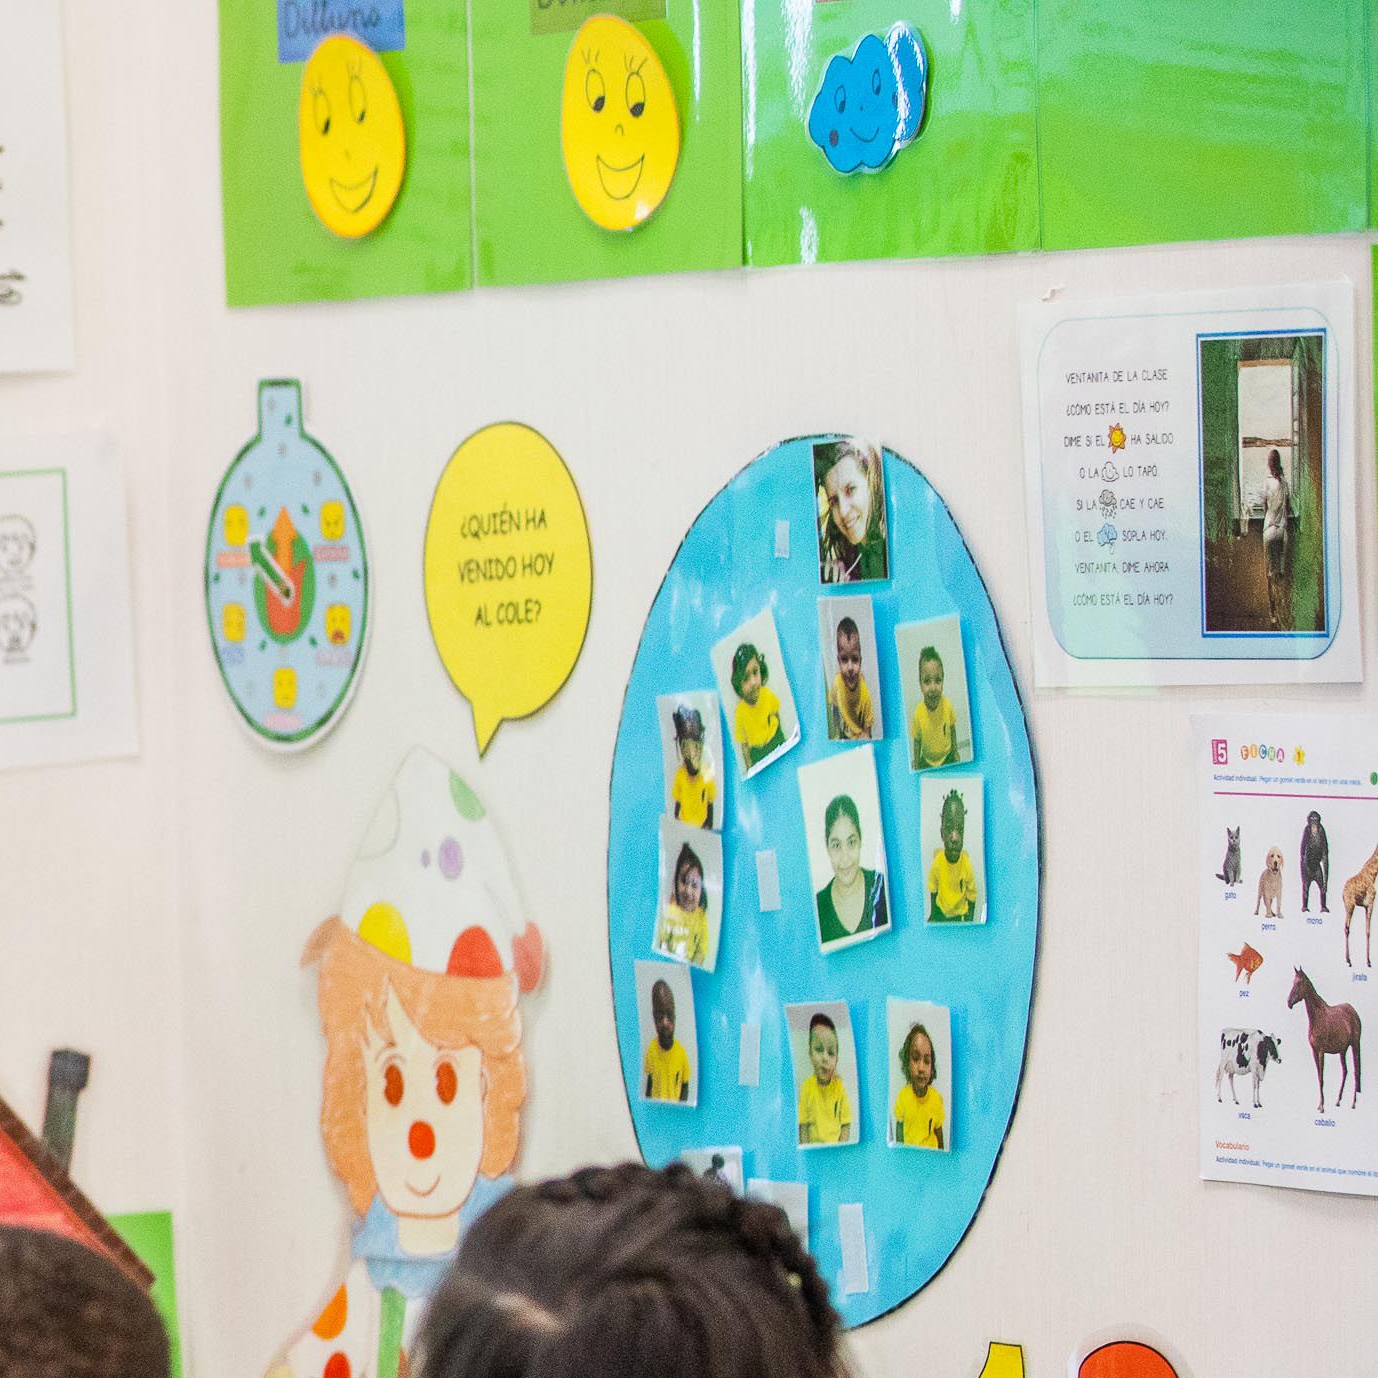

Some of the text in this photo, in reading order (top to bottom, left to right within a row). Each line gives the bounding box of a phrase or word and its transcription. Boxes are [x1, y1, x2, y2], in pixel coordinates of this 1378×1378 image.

[1065, 368, 1169, 384] VENTANITA DE LA CLASE
[1095, 401, 1116, 415] ESTÁ
[1119, 402, 1130, 414] EL
[1132, 400, 1146, 414] DÍA
[1149, 400, 1170, 414] HOY?
[1064, 435, 1082, 447] DIME
[1085, 435, 1093, 447] SI
[1095, 435, 1106, 447] EL
[1130, 433, 1142, 445] HA
[1079, 467, 1085, 479] O
[1088, 467, 1099, 479] LA
[1123, 465, 1134, 478] LO
[1086, 499, 1097, 511] LA
[1120, 498, 1136, 510] CAE
[1139, 498, 1145, 509] Y
[1147, 497, 1165, 509] CAE
[460, 501, 547, 540] ¿QUIÉN HA
[1083, 531, 1094, 542] EL
[1122, 530, 1147, 542] SOPLA
[458, 552, 555, 584] VENIDO HOY
[1122, 561, 1141, 573] DIME
[1144, 561, 1170, 573] AHORA
[1123, 593, 1134, 606] EL
[1137, 592, 1151, 606] DÍA
[1153, 593, 1174, 606] HOY?
[475, 599, 542, 627] AL COLE?
[1306, 917, 1323, 925] mono
[1215, 1140, 1250, 1151] Vocabulario
